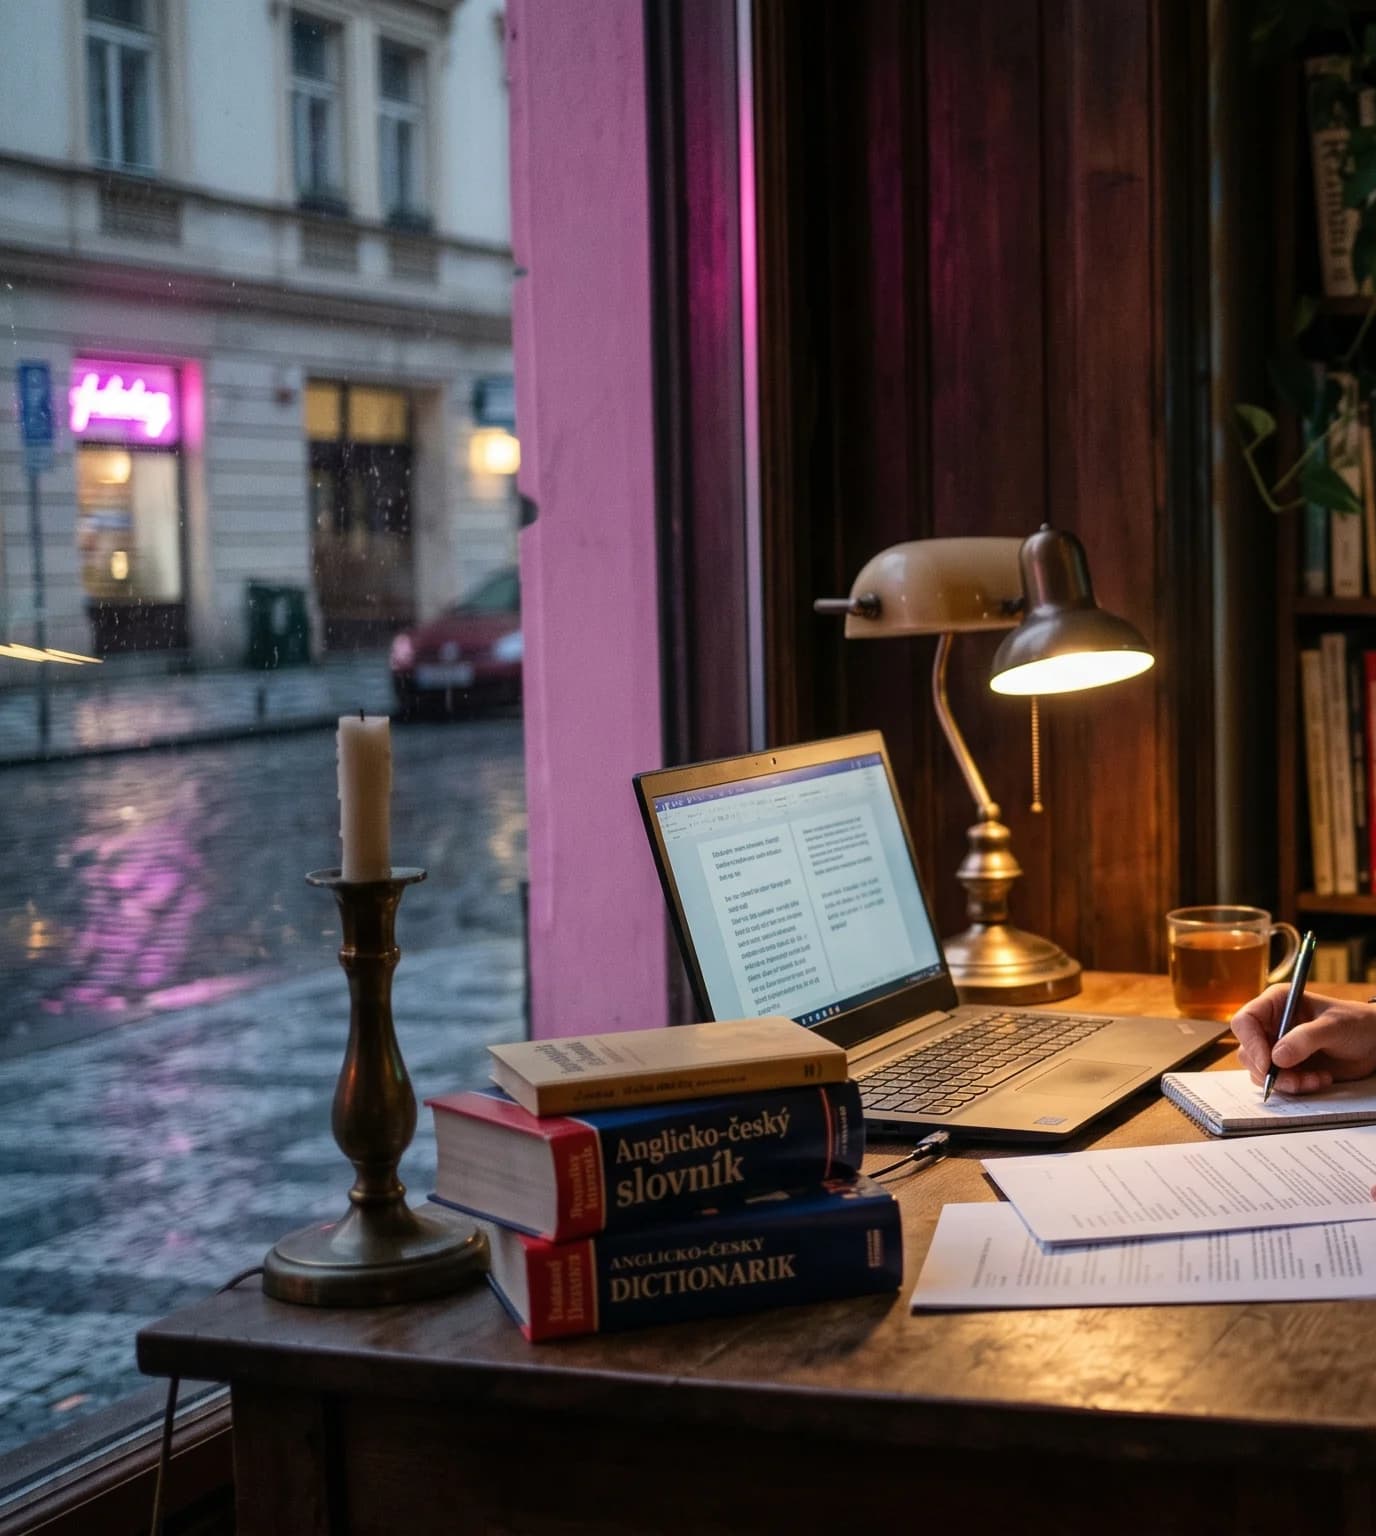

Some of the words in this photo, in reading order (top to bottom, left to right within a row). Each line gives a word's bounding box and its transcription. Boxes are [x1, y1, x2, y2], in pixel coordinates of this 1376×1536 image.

[615, 1106, 790, 1165] Anglicko-český
[616, 1149, 745, 1208] slovník
[608, 1253, 798, 1303] DICTIONARIK
